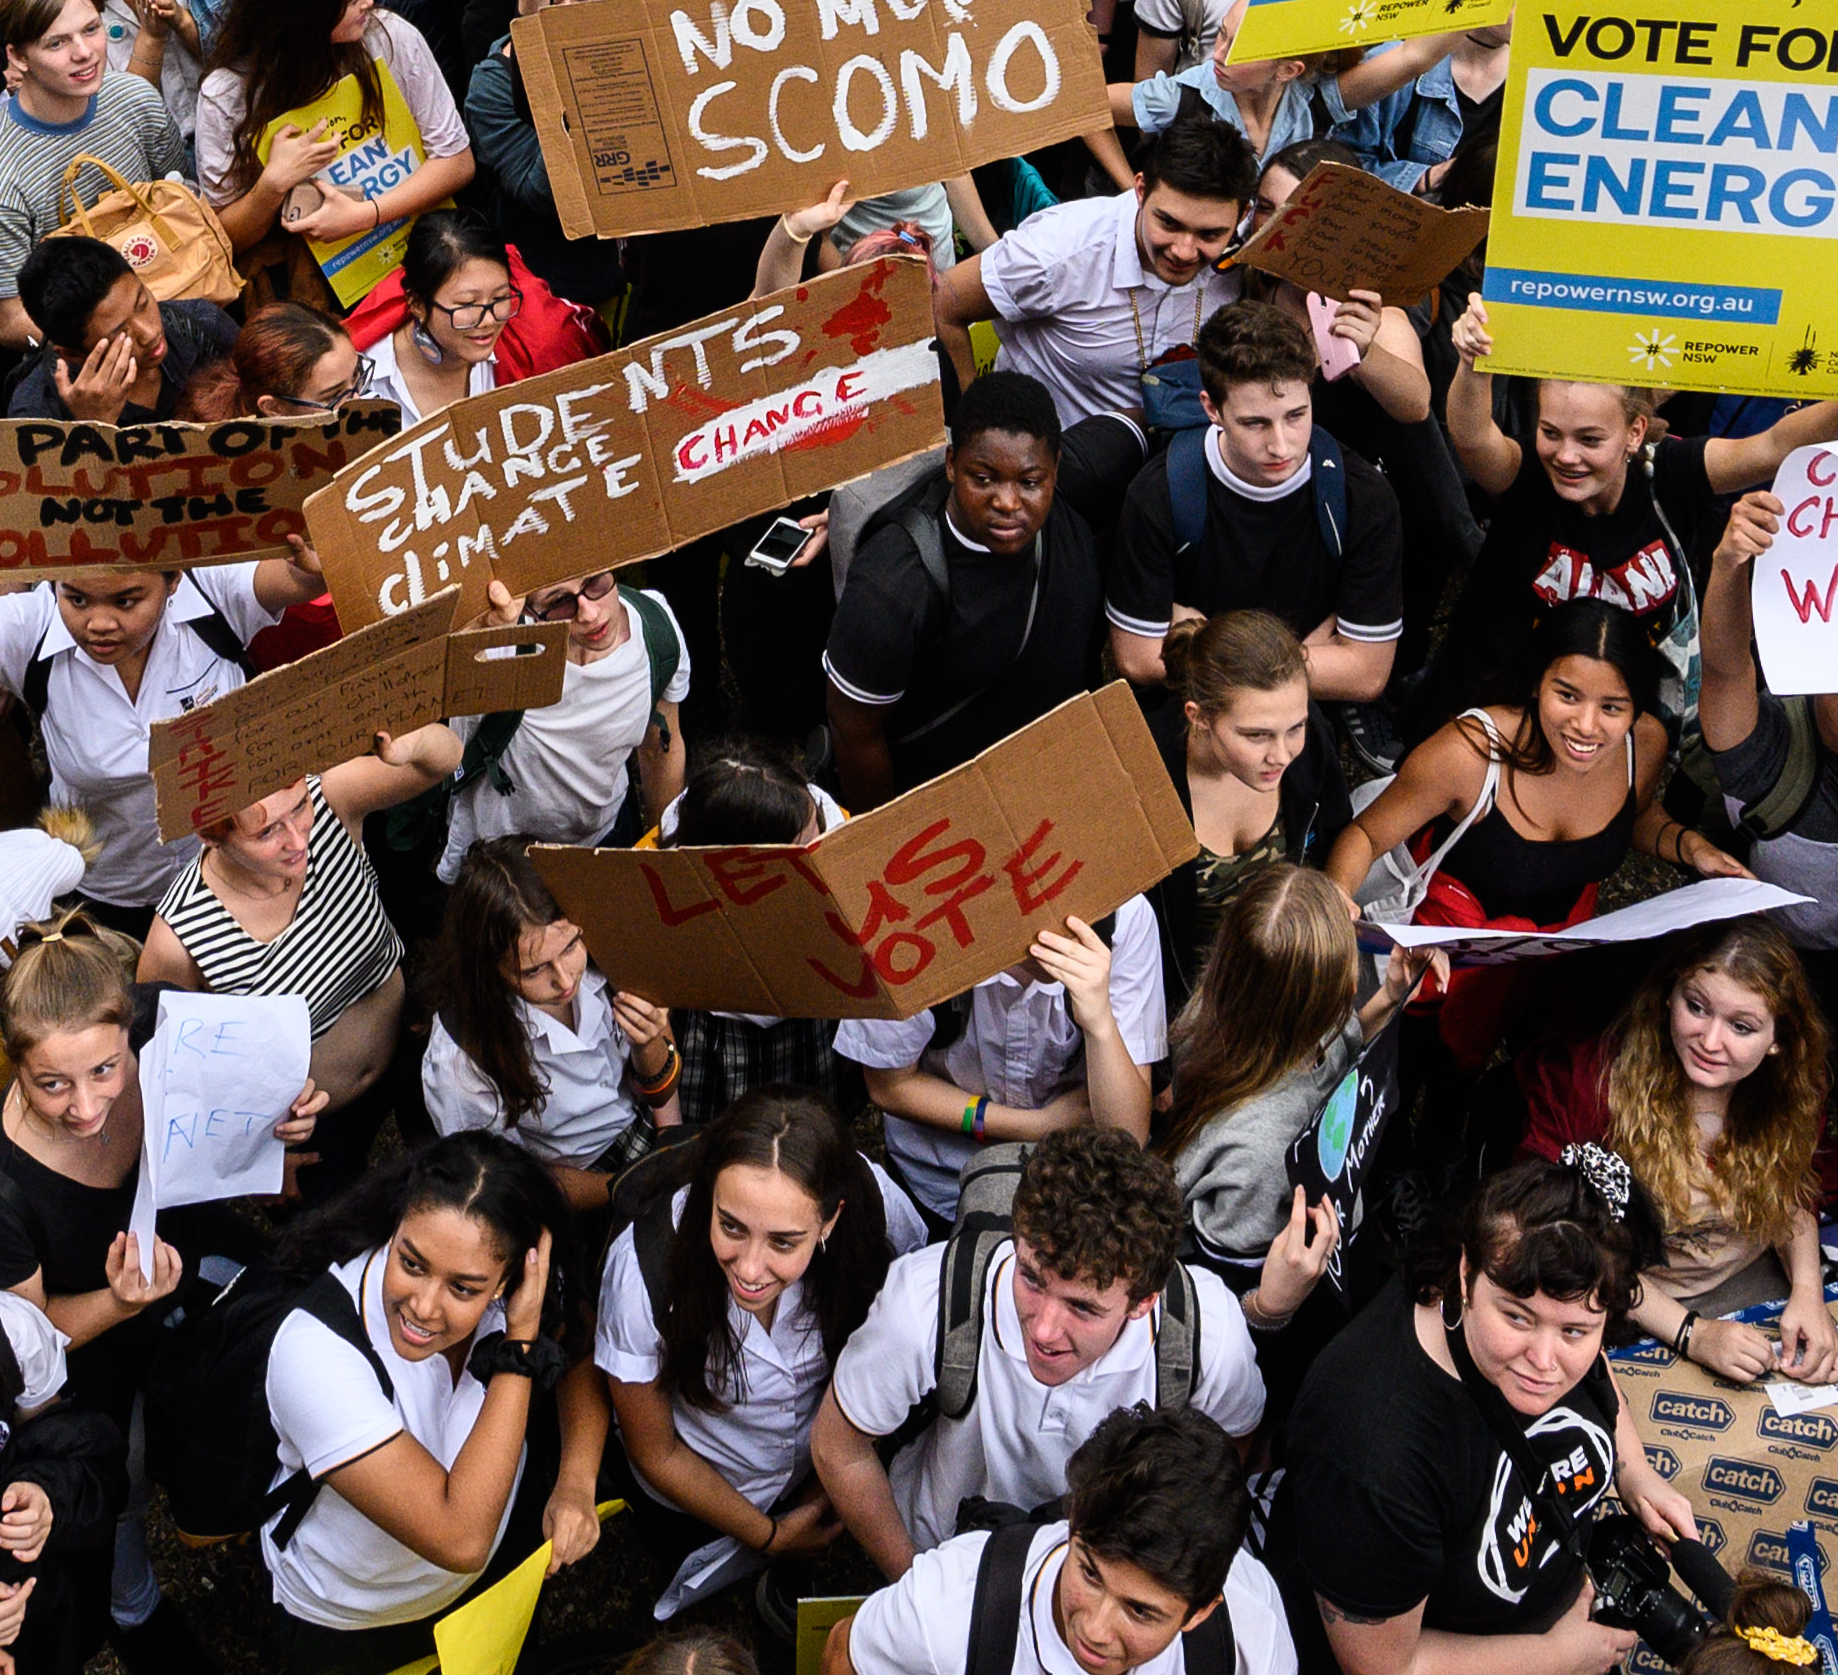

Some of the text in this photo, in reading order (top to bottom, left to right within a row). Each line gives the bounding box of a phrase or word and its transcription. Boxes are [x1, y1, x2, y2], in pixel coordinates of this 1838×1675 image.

[1542, 13, 1714, 67] VOTE
[1510, 275, 1755, 316] repowernsw.org.au
[1682, 350, 1720, 365] NSW
[1683, 339, 1761, 358] REPOWER
[1655, 1395, 1729, 1428] catch
